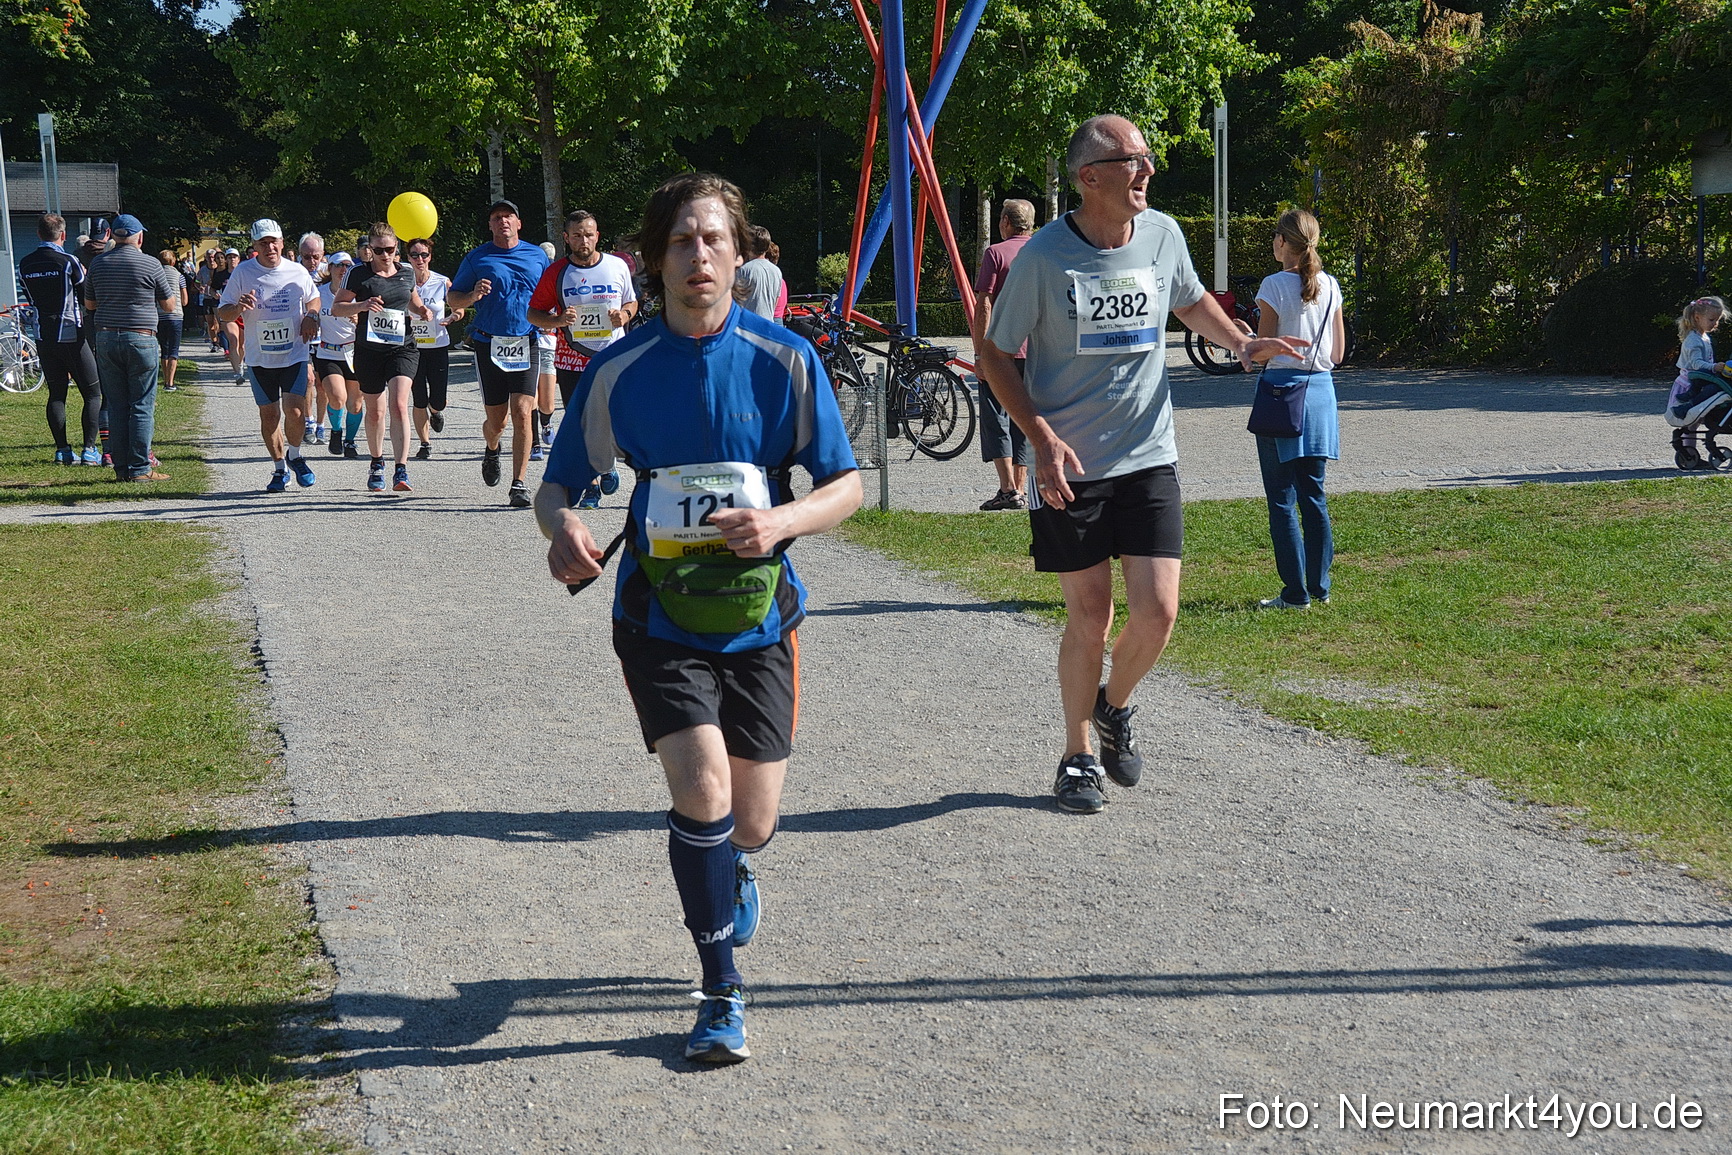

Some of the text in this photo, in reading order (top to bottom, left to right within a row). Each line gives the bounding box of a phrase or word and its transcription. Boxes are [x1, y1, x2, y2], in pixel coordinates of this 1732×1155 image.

[26, 271, 59, 279] NALINI
[1101, 277, 1136, 288] BOCK
[1090, 292, 1149, 321] 2382
[373, 316, 399, 330] 3047
[580, 313, 601, 326] 221
[1096, 323, 1114, 331] PARTL
[263, 327, 289, 341] 2117
[1102, 333, 1140, 346] Johann
[496, 345, 524, 357] 2024
[681, 474, 734, 488] BOCK
[677, 493, 735, 527] 121
[700, 531, 722, 539] Neum
